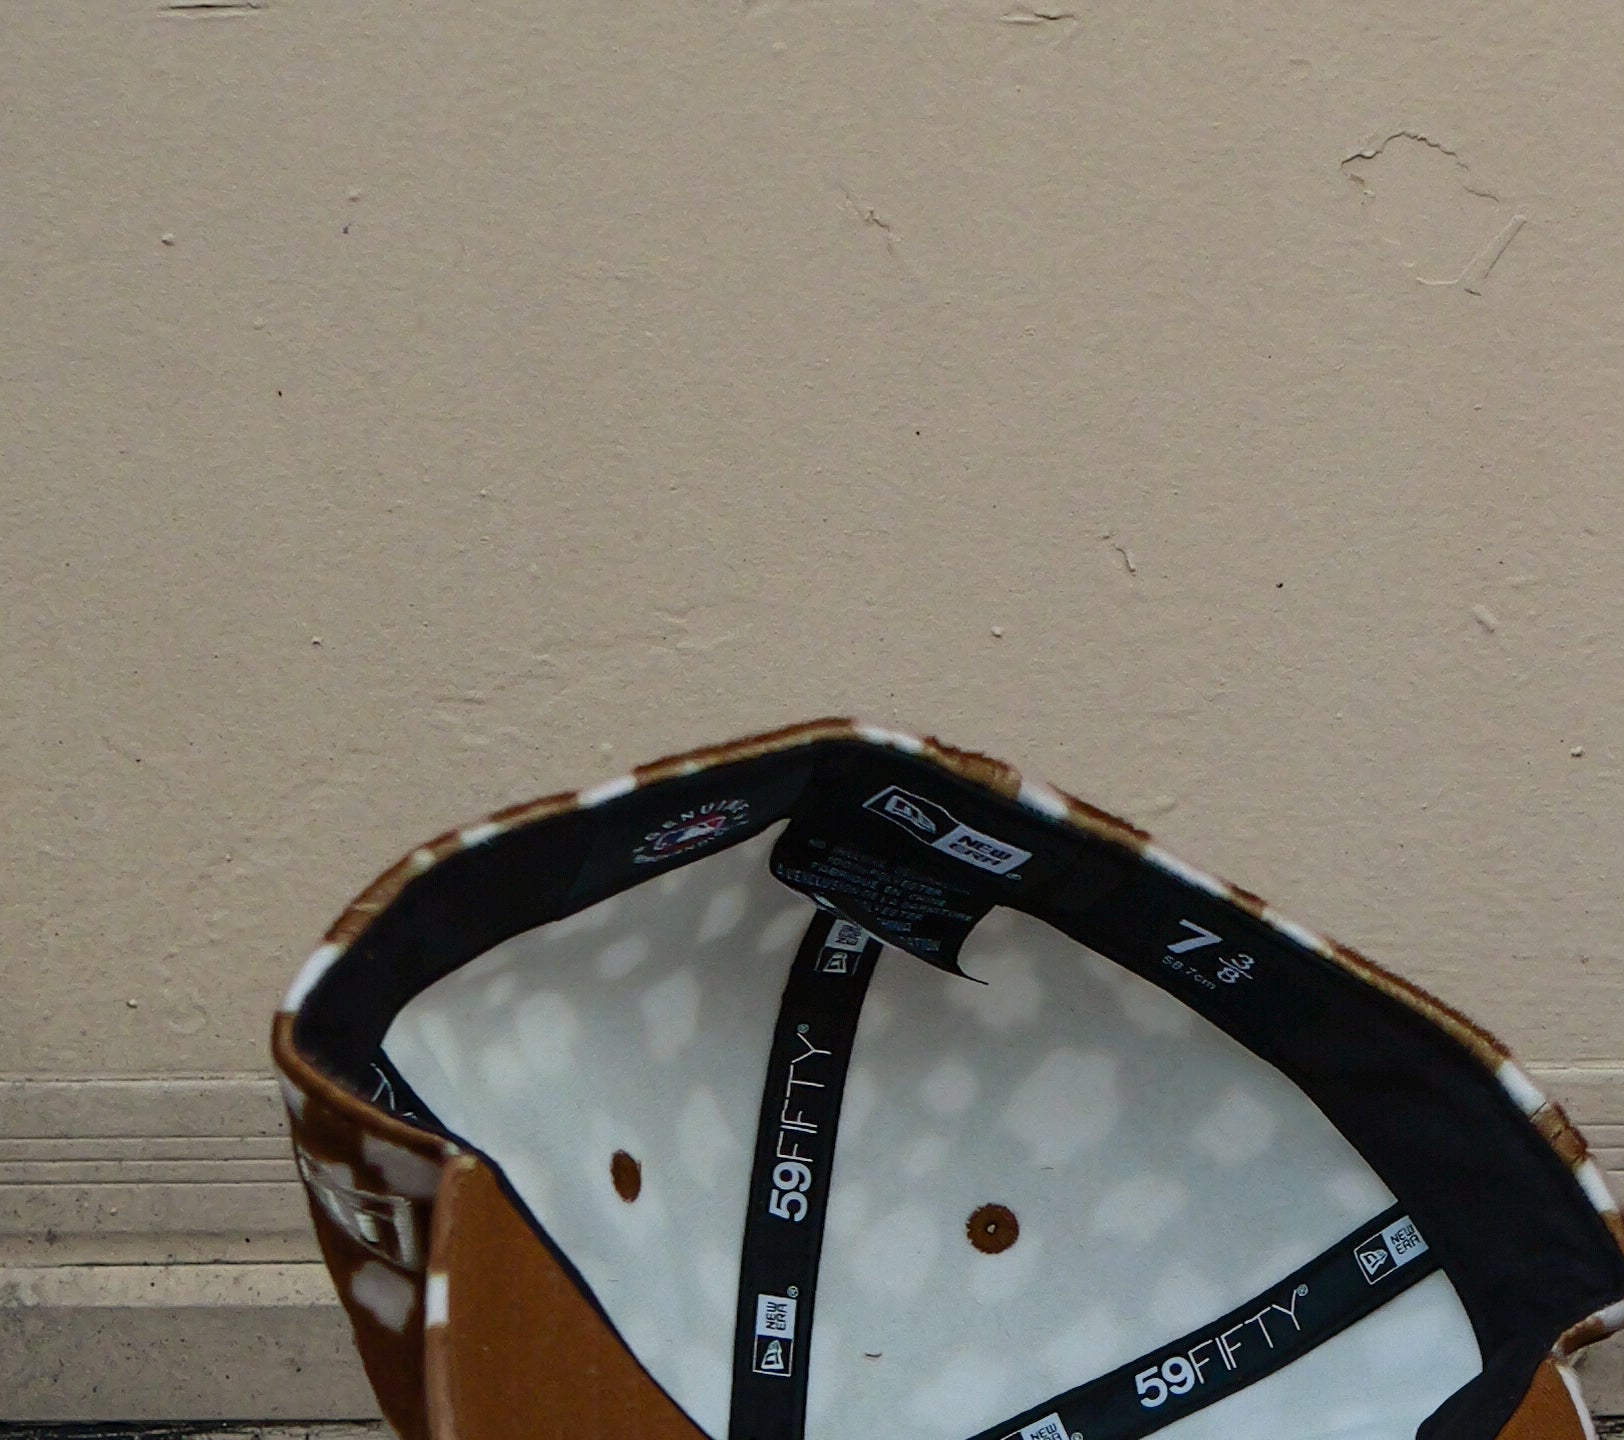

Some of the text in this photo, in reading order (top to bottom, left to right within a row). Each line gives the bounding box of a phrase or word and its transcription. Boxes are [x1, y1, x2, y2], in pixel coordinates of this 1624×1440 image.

[948, 843, 1002, 867] ERA
[957, 835, 1013, 861] NEW
[1166, 918, 1224, 954] 7
[768, 1032, 832, 1222] 59FIFTY
[1389, 1224, 1416, 1245] NEW
[1395, 1234, 1421, 1255] ERA
[765, 1301, 777, 1330] NEW
[775, 1303, 788, 1331] ERA
[1134, 1289, 1301, 1408] 59FIFTY
